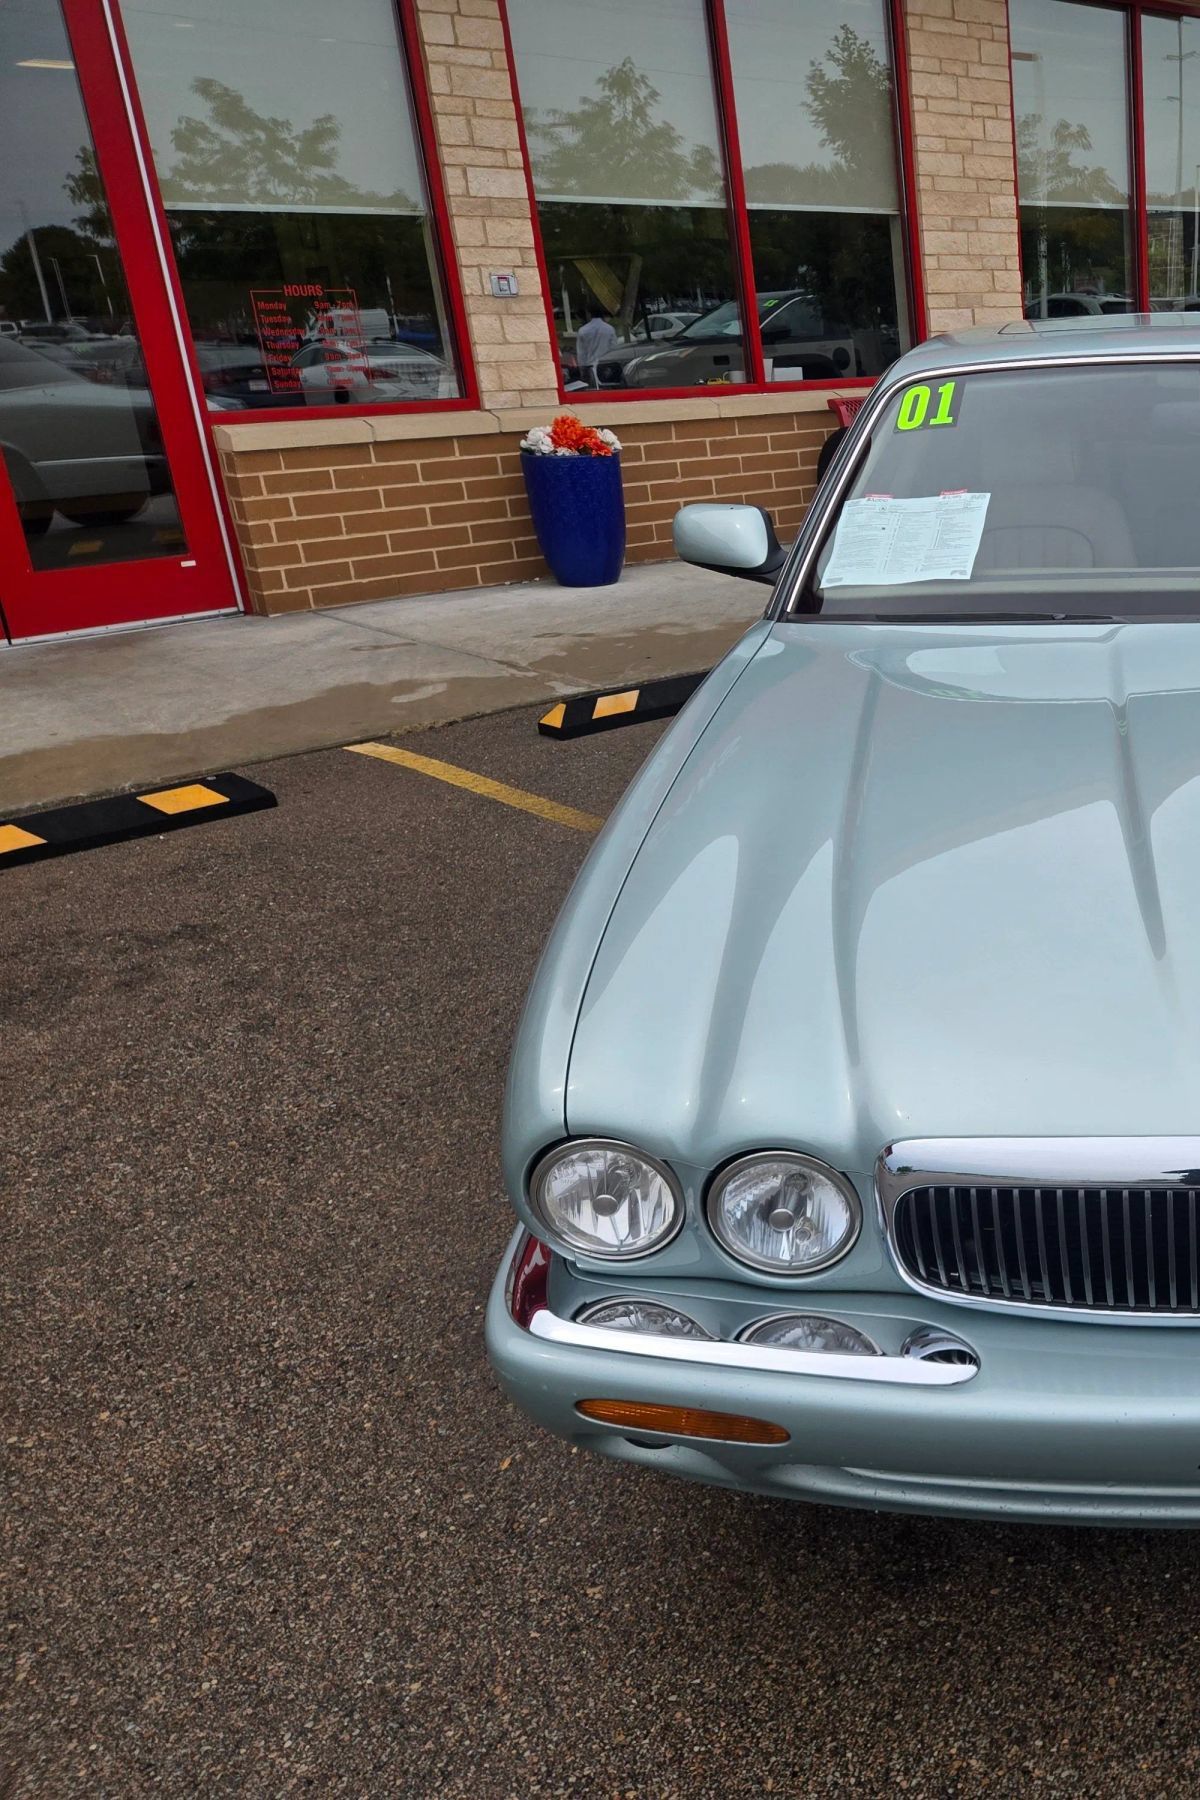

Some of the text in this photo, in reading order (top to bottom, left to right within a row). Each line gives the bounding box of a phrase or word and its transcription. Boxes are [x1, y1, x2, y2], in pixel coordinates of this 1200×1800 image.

[283, 284, 323, 296] HOURS
[257, 301, 286, 311] Monday
[314, 300, 330, 309] 9am
[260, 315, 291, 324] Tuesday
[263, 328, 304, 337] Wednesday
[266, 341, 299, 350] Thursday
[268, 354, 291, 365] Friday
[273, 381, 301, 389] Sunday
[897, 382, 955, 430] 01
